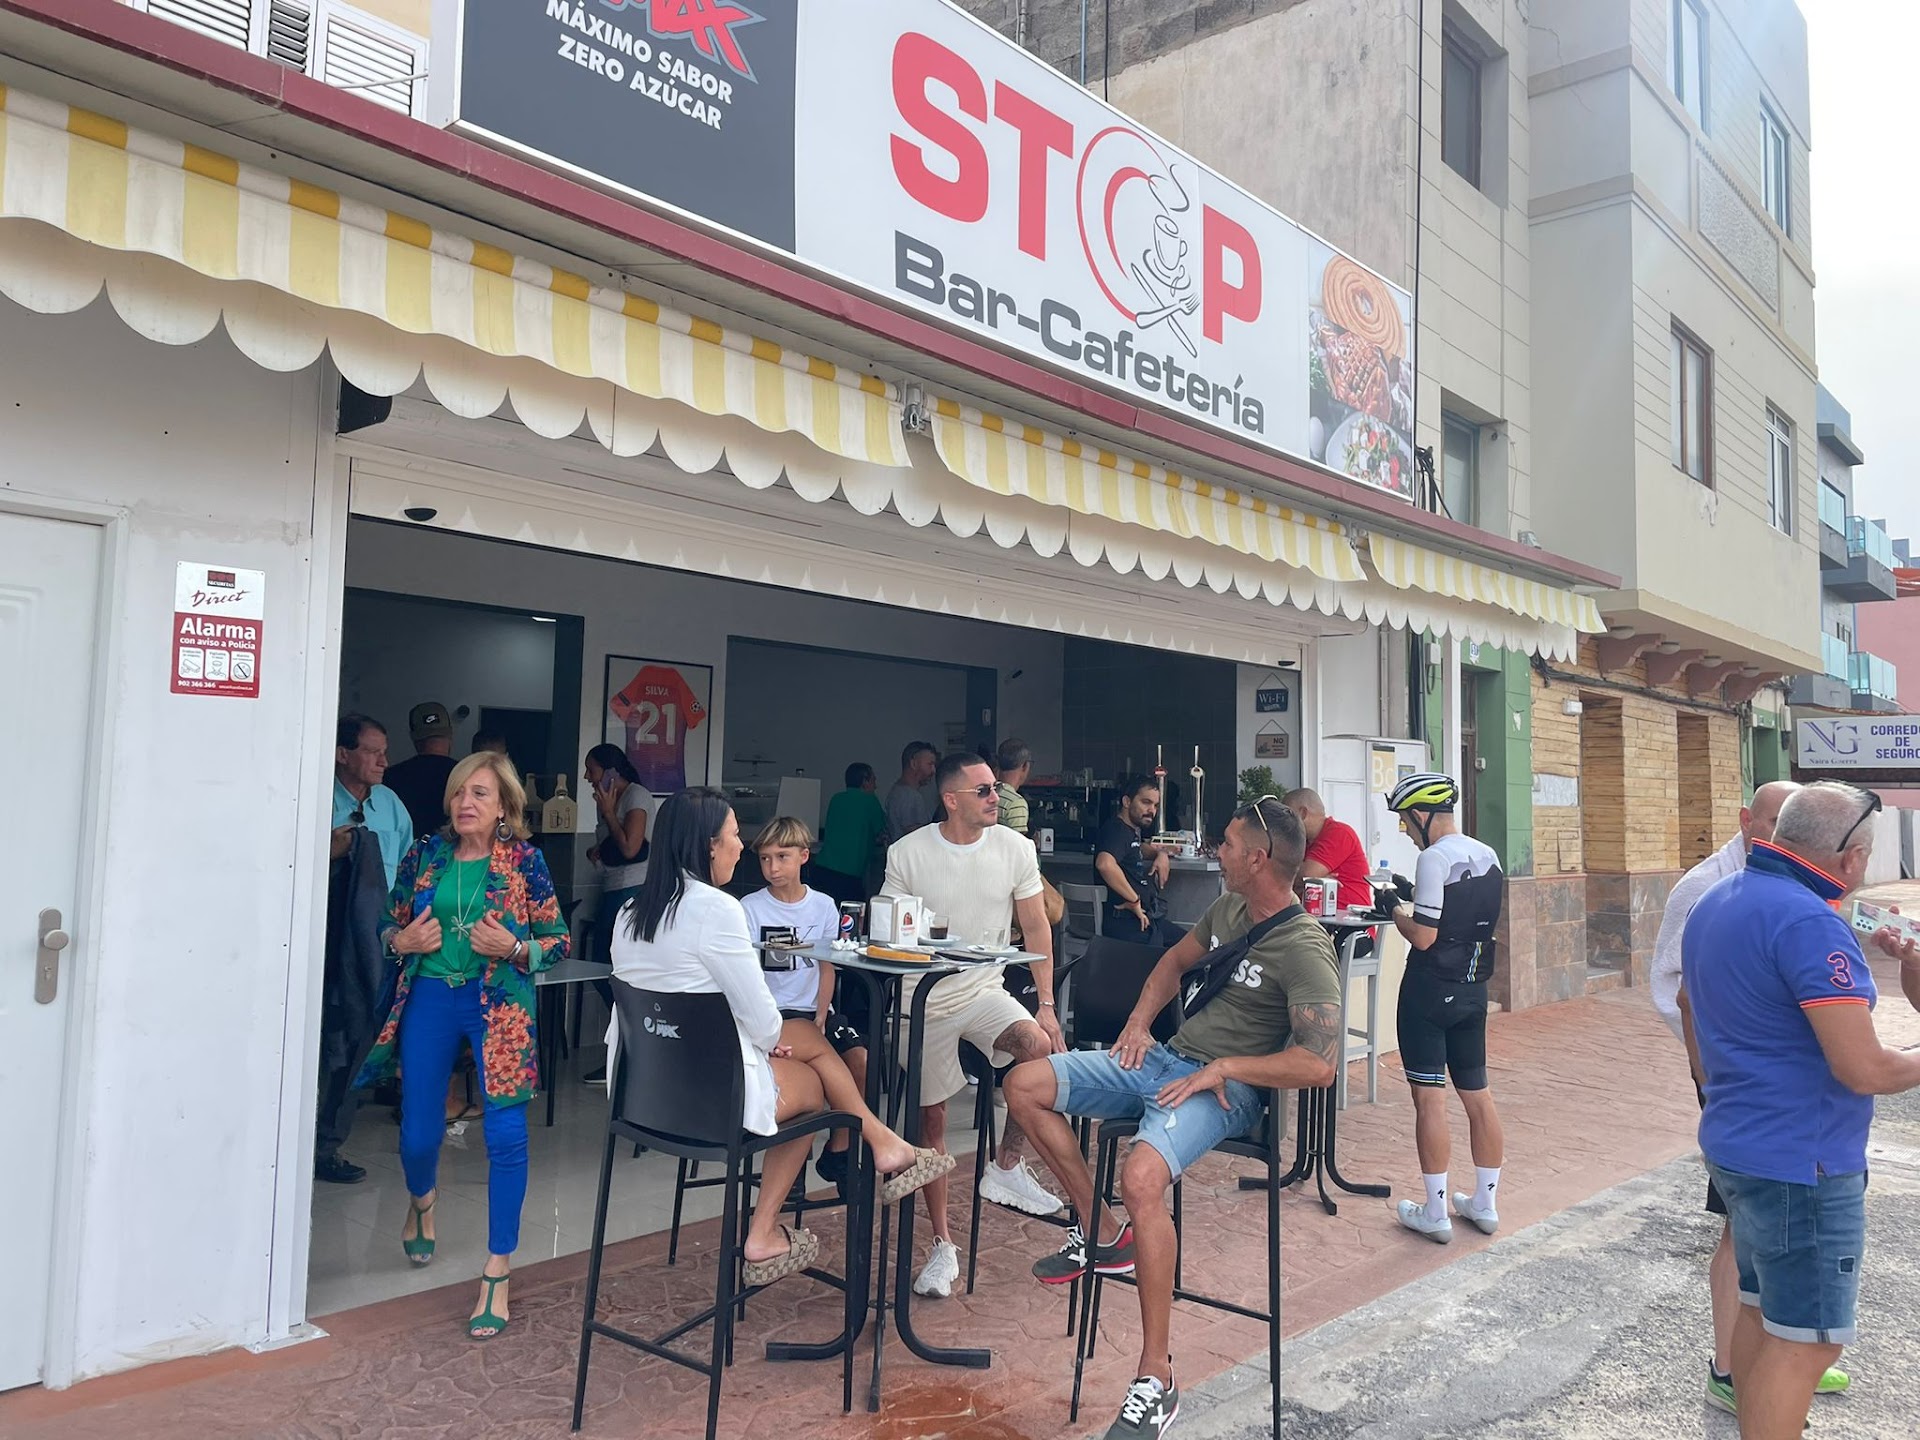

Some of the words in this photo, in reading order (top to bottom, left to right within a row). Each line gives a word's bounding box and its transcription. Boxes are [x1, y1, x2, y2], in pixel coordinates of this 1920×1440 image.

[545, 0, 652, 63] MÁXIMO
[657, 51, 733, 104] SABOR
[557, 33, 625, 82] ZERO
[629, 71, 722, 130] AZÚCAR
[895, 229, 1264, 434] Bar-Cafetería
[191, 590, 251, 607] Direct
[180, 617, 256, 640] Alarma
[180, 637, 195, 645] con
[197, 638, 219, 647] aviso
[645, 686, 669, 696] SILVA
[1259, 692, 1284, 703] Wi-Fi
[635, 701, 676, 745] 21
[1871, 724, 1920, 736] CORRED
[1895, 736, 1910, 747] DE
[1827, 951, 1856, 990] 3
